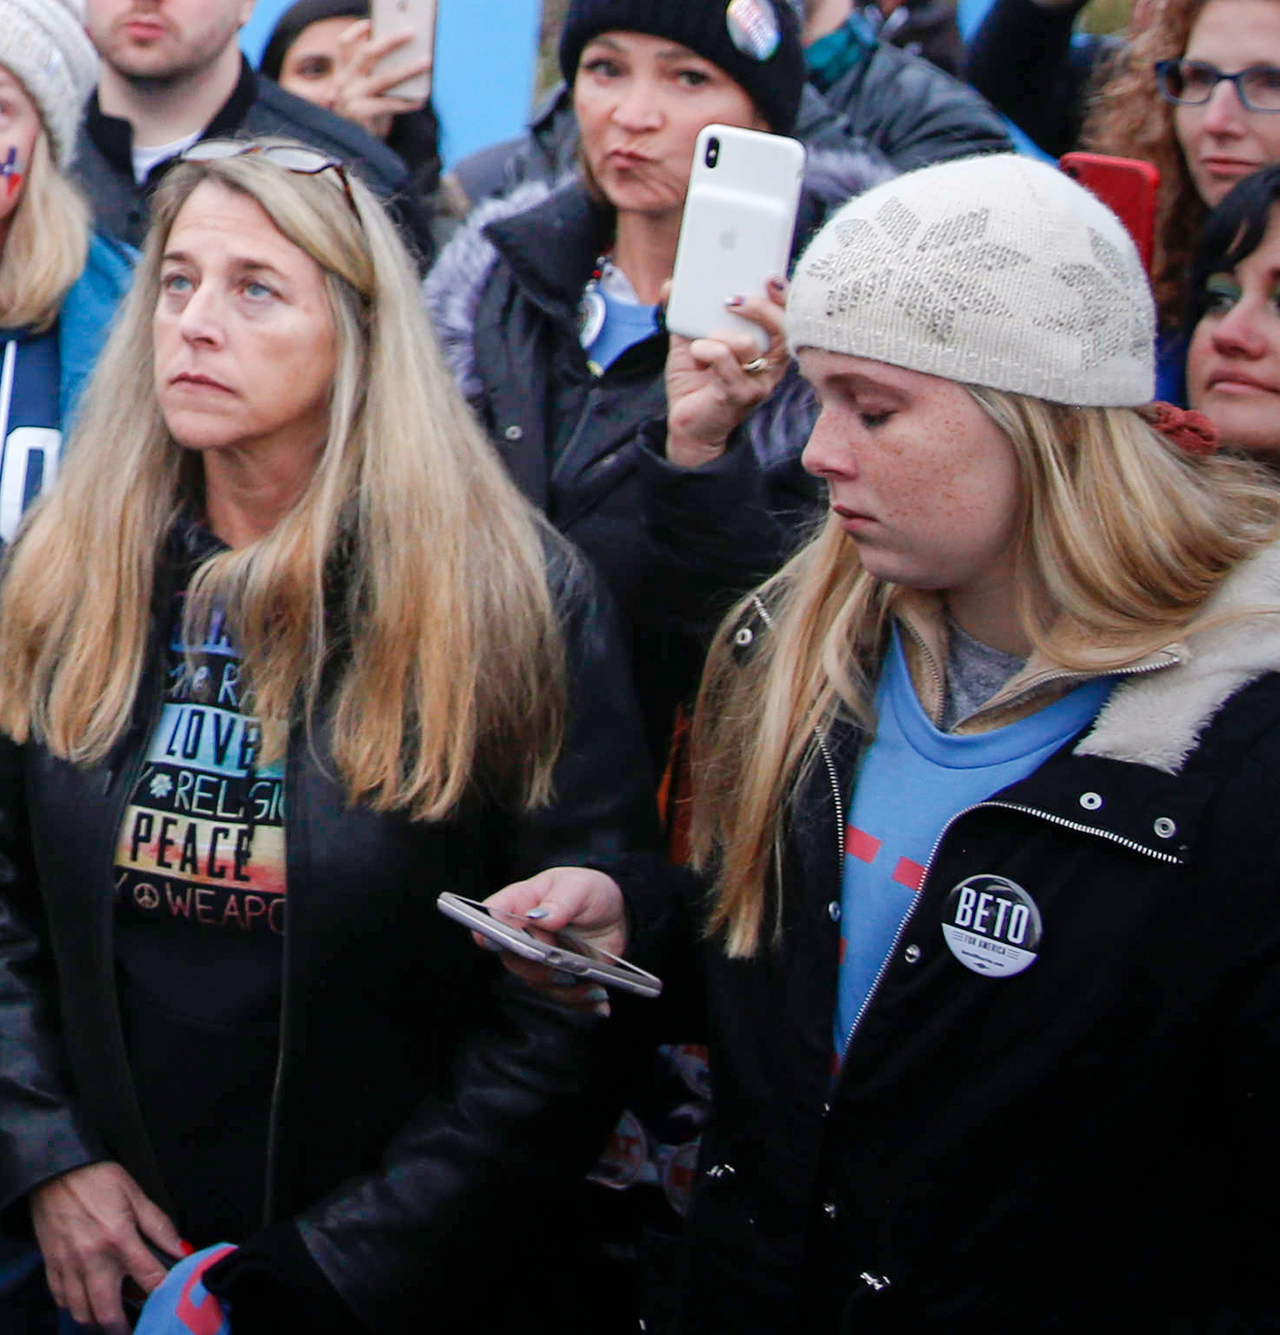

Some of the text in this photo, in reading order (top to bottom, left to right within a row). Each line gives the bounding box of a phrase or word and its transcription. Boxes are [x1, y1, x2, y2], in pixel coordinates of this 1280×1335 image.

[165, 708, 259, 771] LOVE
[130, 810, 255, 883] PEACE
[954, 886, 1030, 945] BETO
